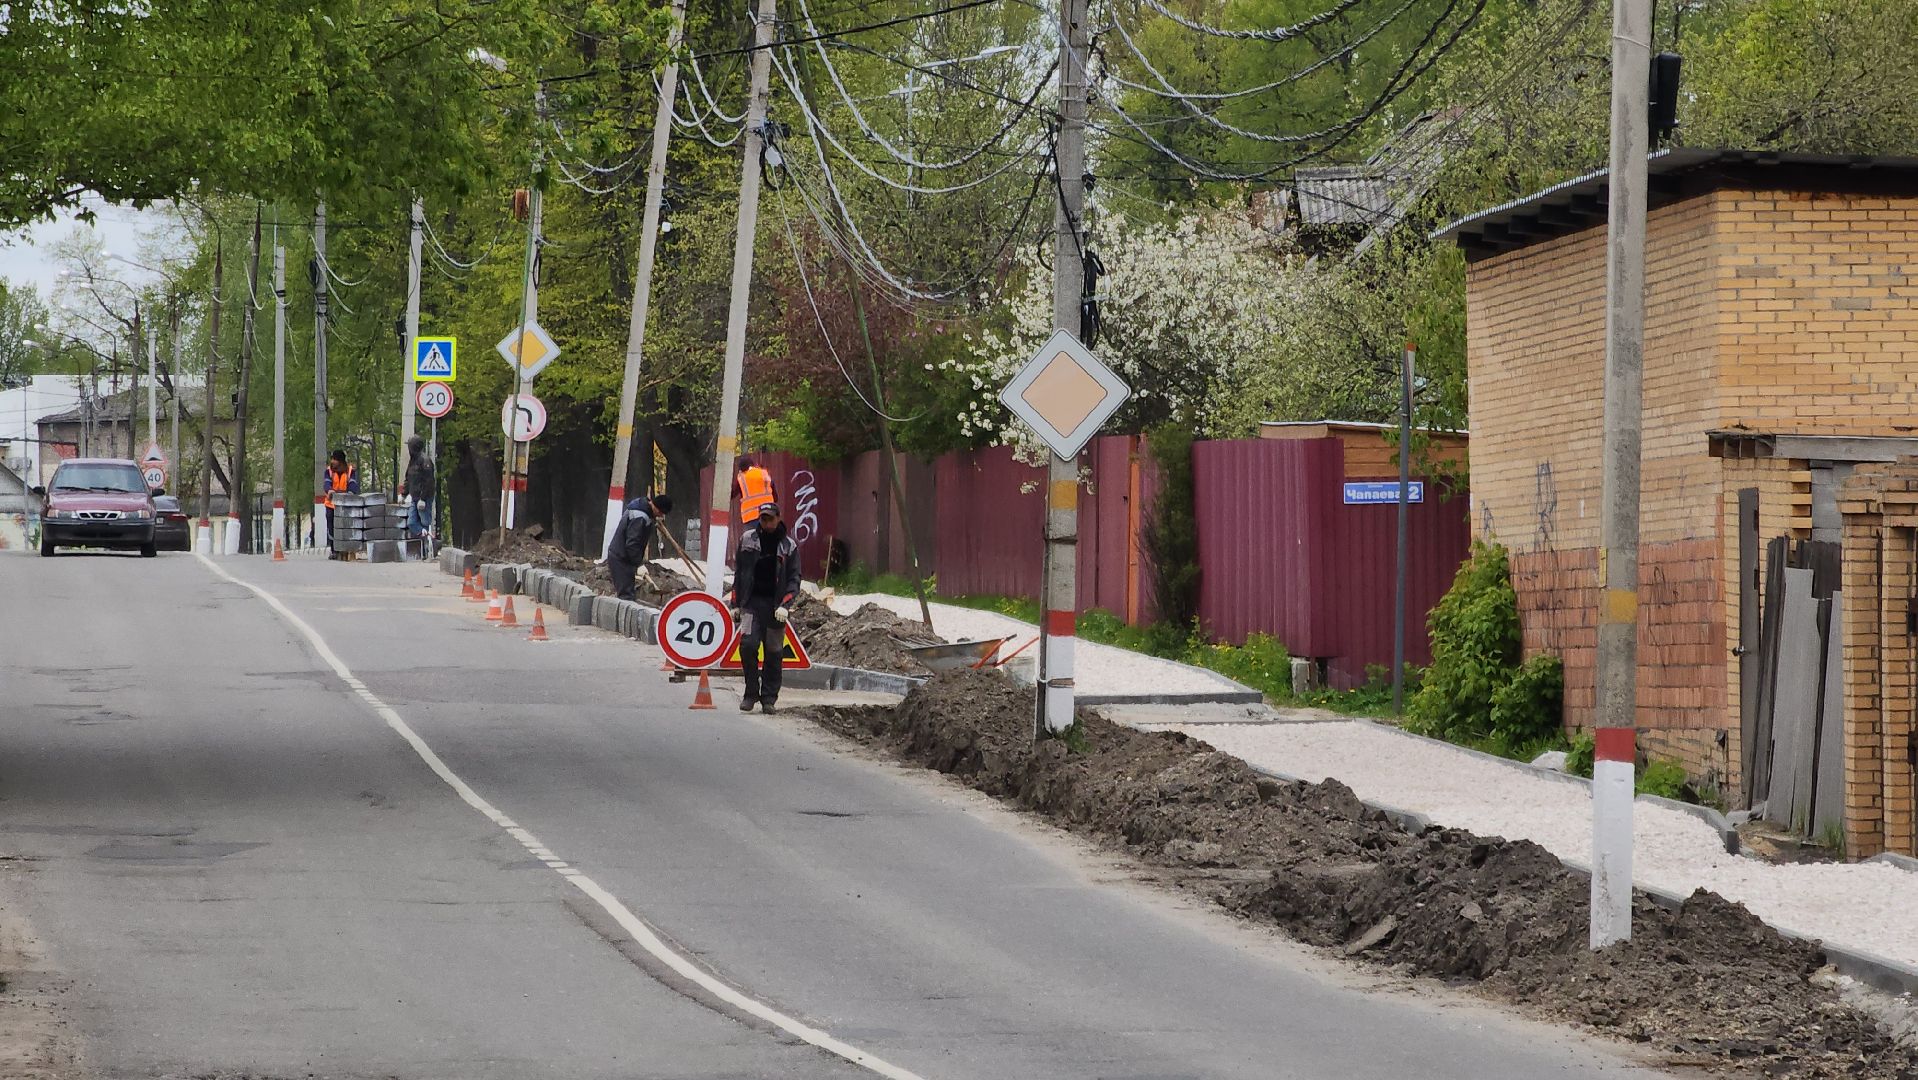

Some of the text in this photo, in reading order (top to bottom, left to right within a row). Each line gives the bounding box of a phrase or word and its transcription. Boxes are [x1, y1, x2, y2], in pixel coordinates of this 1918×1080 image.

[426, 392, 446, 406] 20
[148, 473, 161, 482] 40
[1408, 486, 1420, 500] 2
[674, 617, 715, 646] 20
